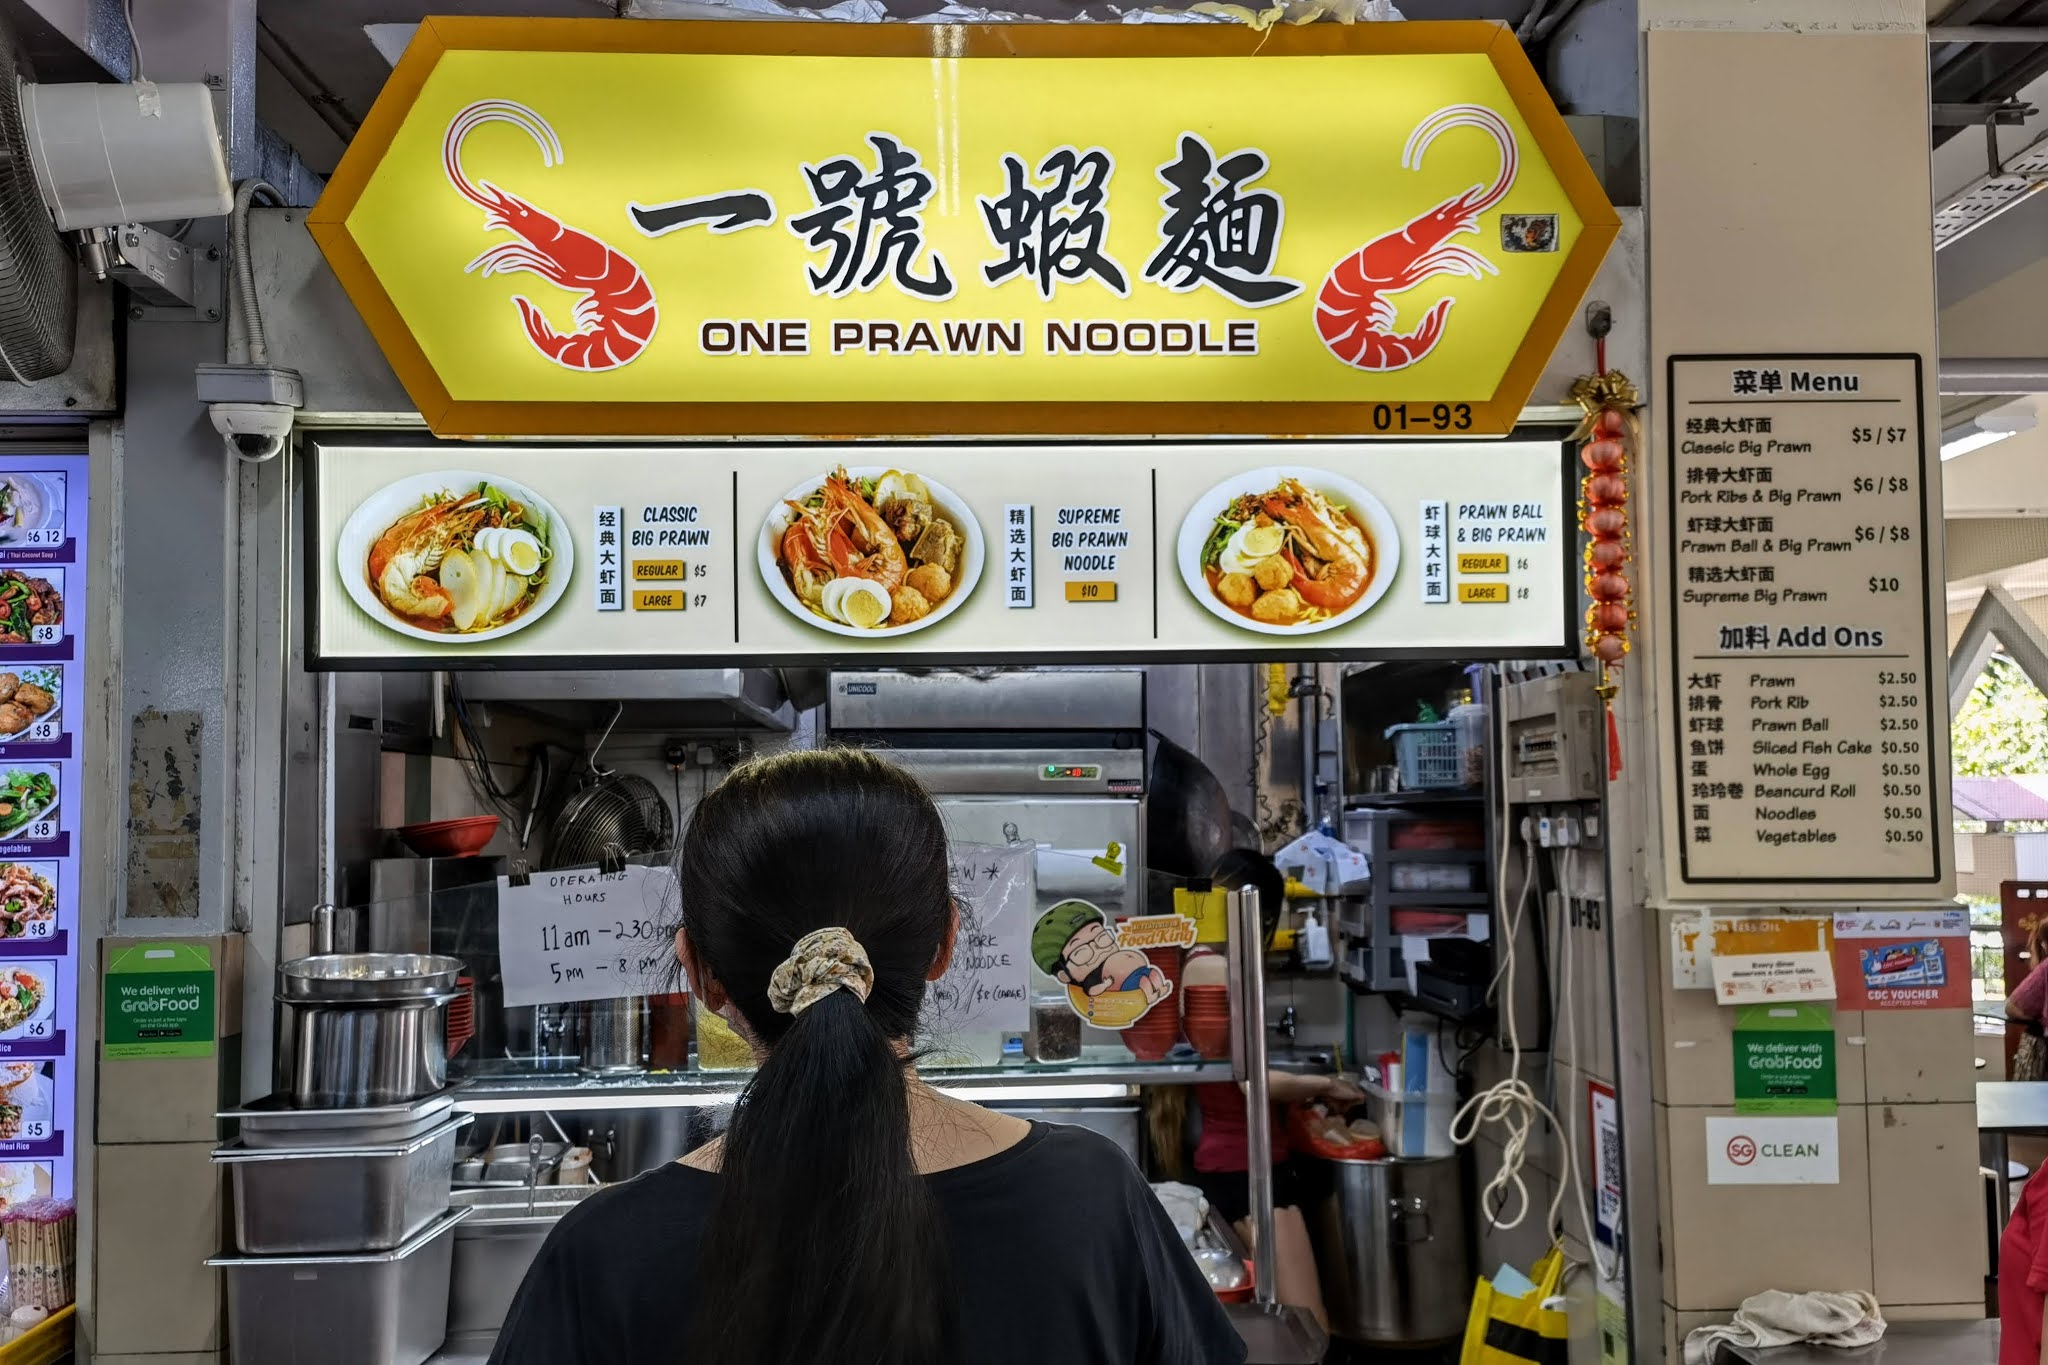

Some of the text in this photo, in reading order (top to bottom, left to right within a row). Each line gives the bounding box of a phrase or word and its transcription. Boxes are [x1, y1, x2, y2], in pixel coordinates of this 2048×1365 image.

[633, 137, 1299, 301] 一號蝦麵
[702, 322, 1256, 352] ONE PRAWN NOODLE
[1733, 370, 1859, 394] 菜单 Menu
[1686, 417, 1772, 434] 经典大虾面
[1852, 427, 1872, 443] $5
[1887, 427, 1907, 443] $7
[1681, 440, 1811, 456] Classic Big Prawn
[1687, 467, 1772, 484] 排骨大虾面
[1853, 477, 1873, 493] $6
[1889, 477, 1908, 493] $8
[1681, 490, 1841, 505] Pork Ribs & Big Prawn
[643, 506, 698, 523] CLASSIC
[1057, 508, 1121, 524] SUPREME
[1459, 505, 1543, 519] PRAWN BALL
[1687, 517, 1773, 533] 虾球大虾面
[28, 531, 60, 543] $6 12
[632, 530, 710, 546] BIG PRAWN
[1052, 532, 1128, 548] BIG PRAWN
[1457, 527, 1547, 542] & BIG PRAWN
[1855, 527, 1875, 542] $6
[1890, 527, 1910, 542] $8
[1425, 506, 1441, 597] 虾球大虾面
[1681, 539, 1852, 555] Prawn Ball & Big Prawn
[599, 511, 616, 604] 经典大虾面
[1009, 509, 1026, 602] 精选大虾面
[1064, 555, 1116, 571] NOODLE
[637, 564, 707, 578] REGULAR $5
[1462, 558, 1528, 570] REGULAR $6
[1688, 566, 1775, 583] 精选大虾面
[1081, 584, 1098, 597] $10
[1869, 577, 1899, 593] $10
[643, 595, 707, 608] LARGE $7
[1468, 588, 1529, 600] LARGE $8
[1683, 590, 1828, 607] Supreme Big Prawn
[38, 627, 53, 640] $8
[1720, 626, 1883, 650] 加料 Add Ons
[1687, 672, 1917, 689] 大虾 Prawn $2.50
[1688, 695, 1918, 712] 排骨 Pork Rib $2.50
[36, 724, 51, 737] $8
[1689, 717, 1919, 734] 虾球 Prawn Ball $2.50
[1753, 740, 1797, 755] Sliced
[1802, 740, 1832, 754] Fish
[1837, 740, 1873, 755] Cake
[1881, 741, 1920, 755] $0.50
[1691, 761, 1921, 780] 蛋 Whole Egg $0.50
[1754, 784, 1825, 798] Beancurd
[1830, 784, 1856, 798] Roll
[1882, 784, 1921, 797] $0.50
[1693, 804, 1922, 821] 面 Noodles $0.50
[34, 822, 49, 836] $8
[1694, 827, 1924, 846] 菜 Vegetables $0.50
[0, 844, 31, 854] egetables
[550, 873, 628, 888] OPERATING
[563, 893, 607, 905] HOURS
[31, 922, 46, 935] $8
[968, 934, 998, 948] PORK
[619, 958, 627, 973] 8
[121, 985, 200, 996] We deliver with
[1868, 989, 1938, 1000] CDC VOUCHER
[121, 996, 200, 1013] GrabFood
[29, 1022, 44, 1035] $6
[1747, 1043, 1822, 1053] We deliver with
[1748, 1054, 1822, 1070] GrabFood
[27, 1123, 43, 1136] $5
[16, 1142, 30, 1151] Rice
[1731, 1143, 1819, 1158] SG CLEAN
